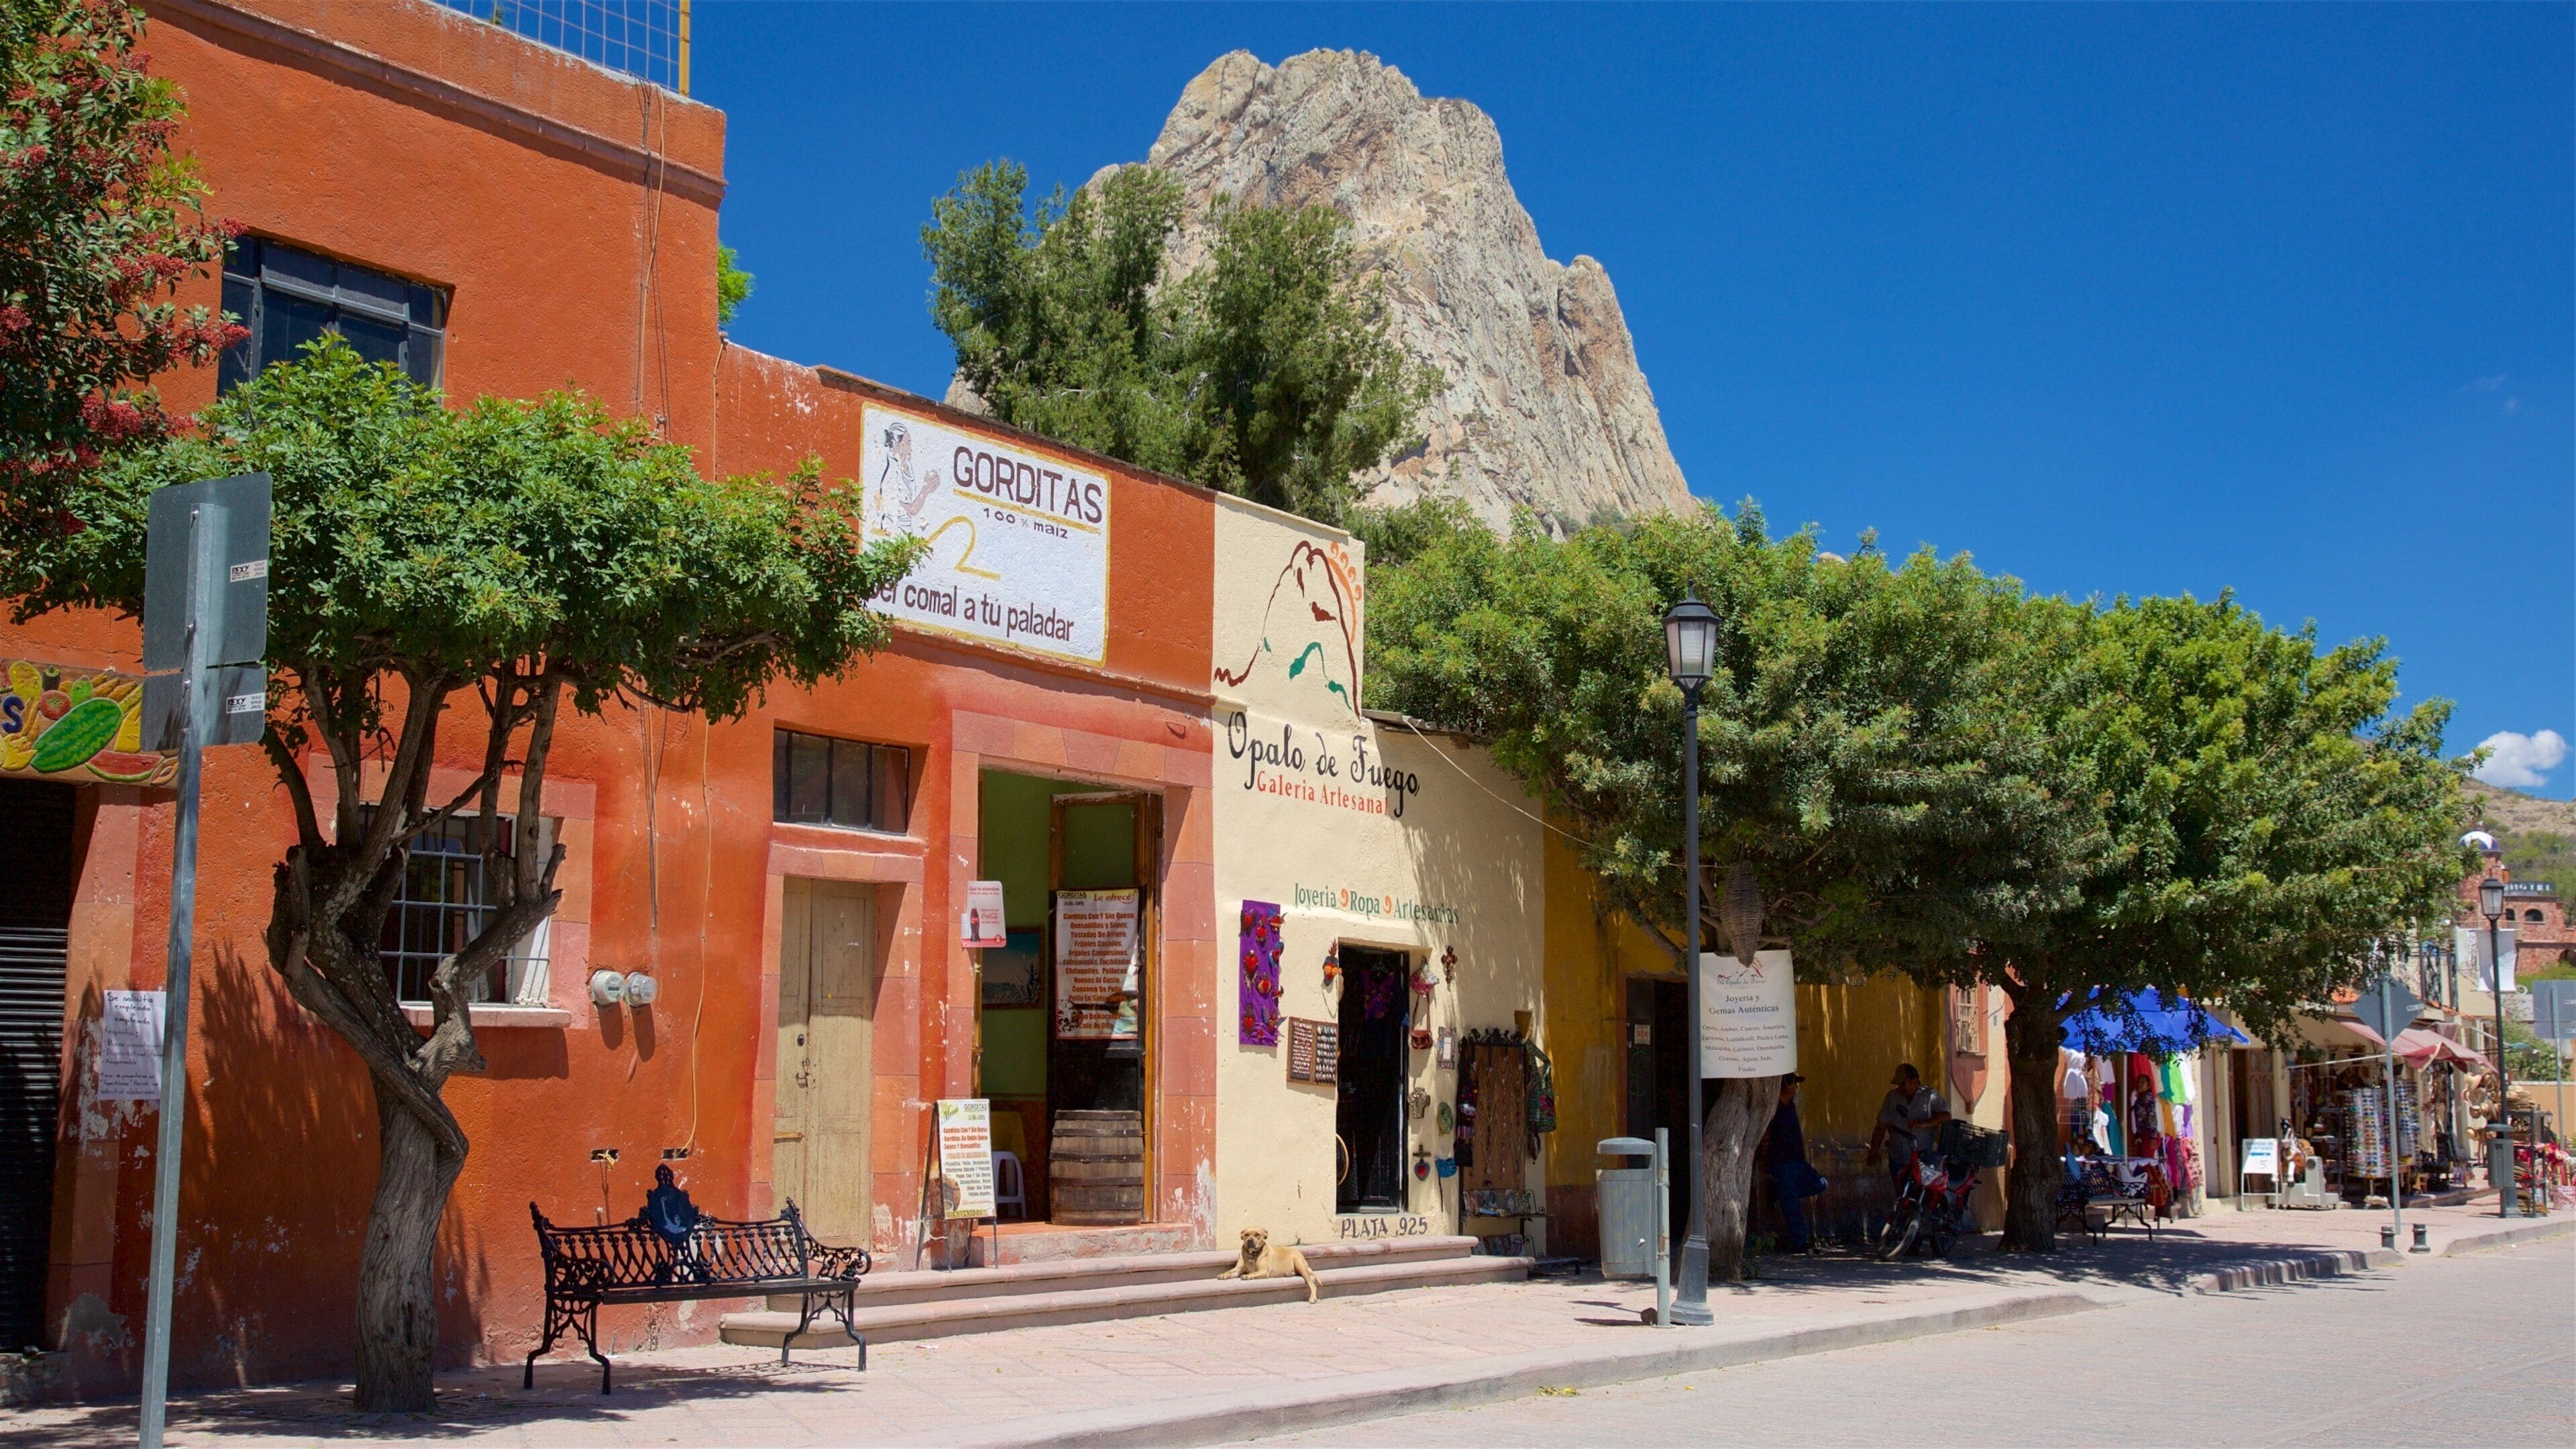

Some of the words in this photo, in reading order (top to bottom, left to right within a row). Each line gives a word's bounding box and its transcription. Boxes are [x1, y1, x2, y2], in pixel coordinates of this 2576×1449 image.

[953, 446, 1102, 523] GORDITAS
[983, 507, 1016, 524] 100
[904, 584, 957, 617] comal
[964, 598, 975, 621] a
[1006, 602, 1074, 643] paladar
[1316, 733, 1338, 777] de
[1257, 770, 1315, 802] Galeria
[1320, 783, 1389, 816] Artesanal
[1293, 883, 1336, 910] Joyeria
[1350, 891, 1380, 920] Ropa
[1393, 897, 1459, 924] Artesanias
[107, 992, 118, 1002] Se
[123, 994, 154, 1003] solicita
[115, 1004, 150, 1012] empleada
[1737, 1005, 1779, 1014] Auténticas
[115, 1017, 150, 1025] empleado
[1341, 1218, 1388, 1239] PLATA
